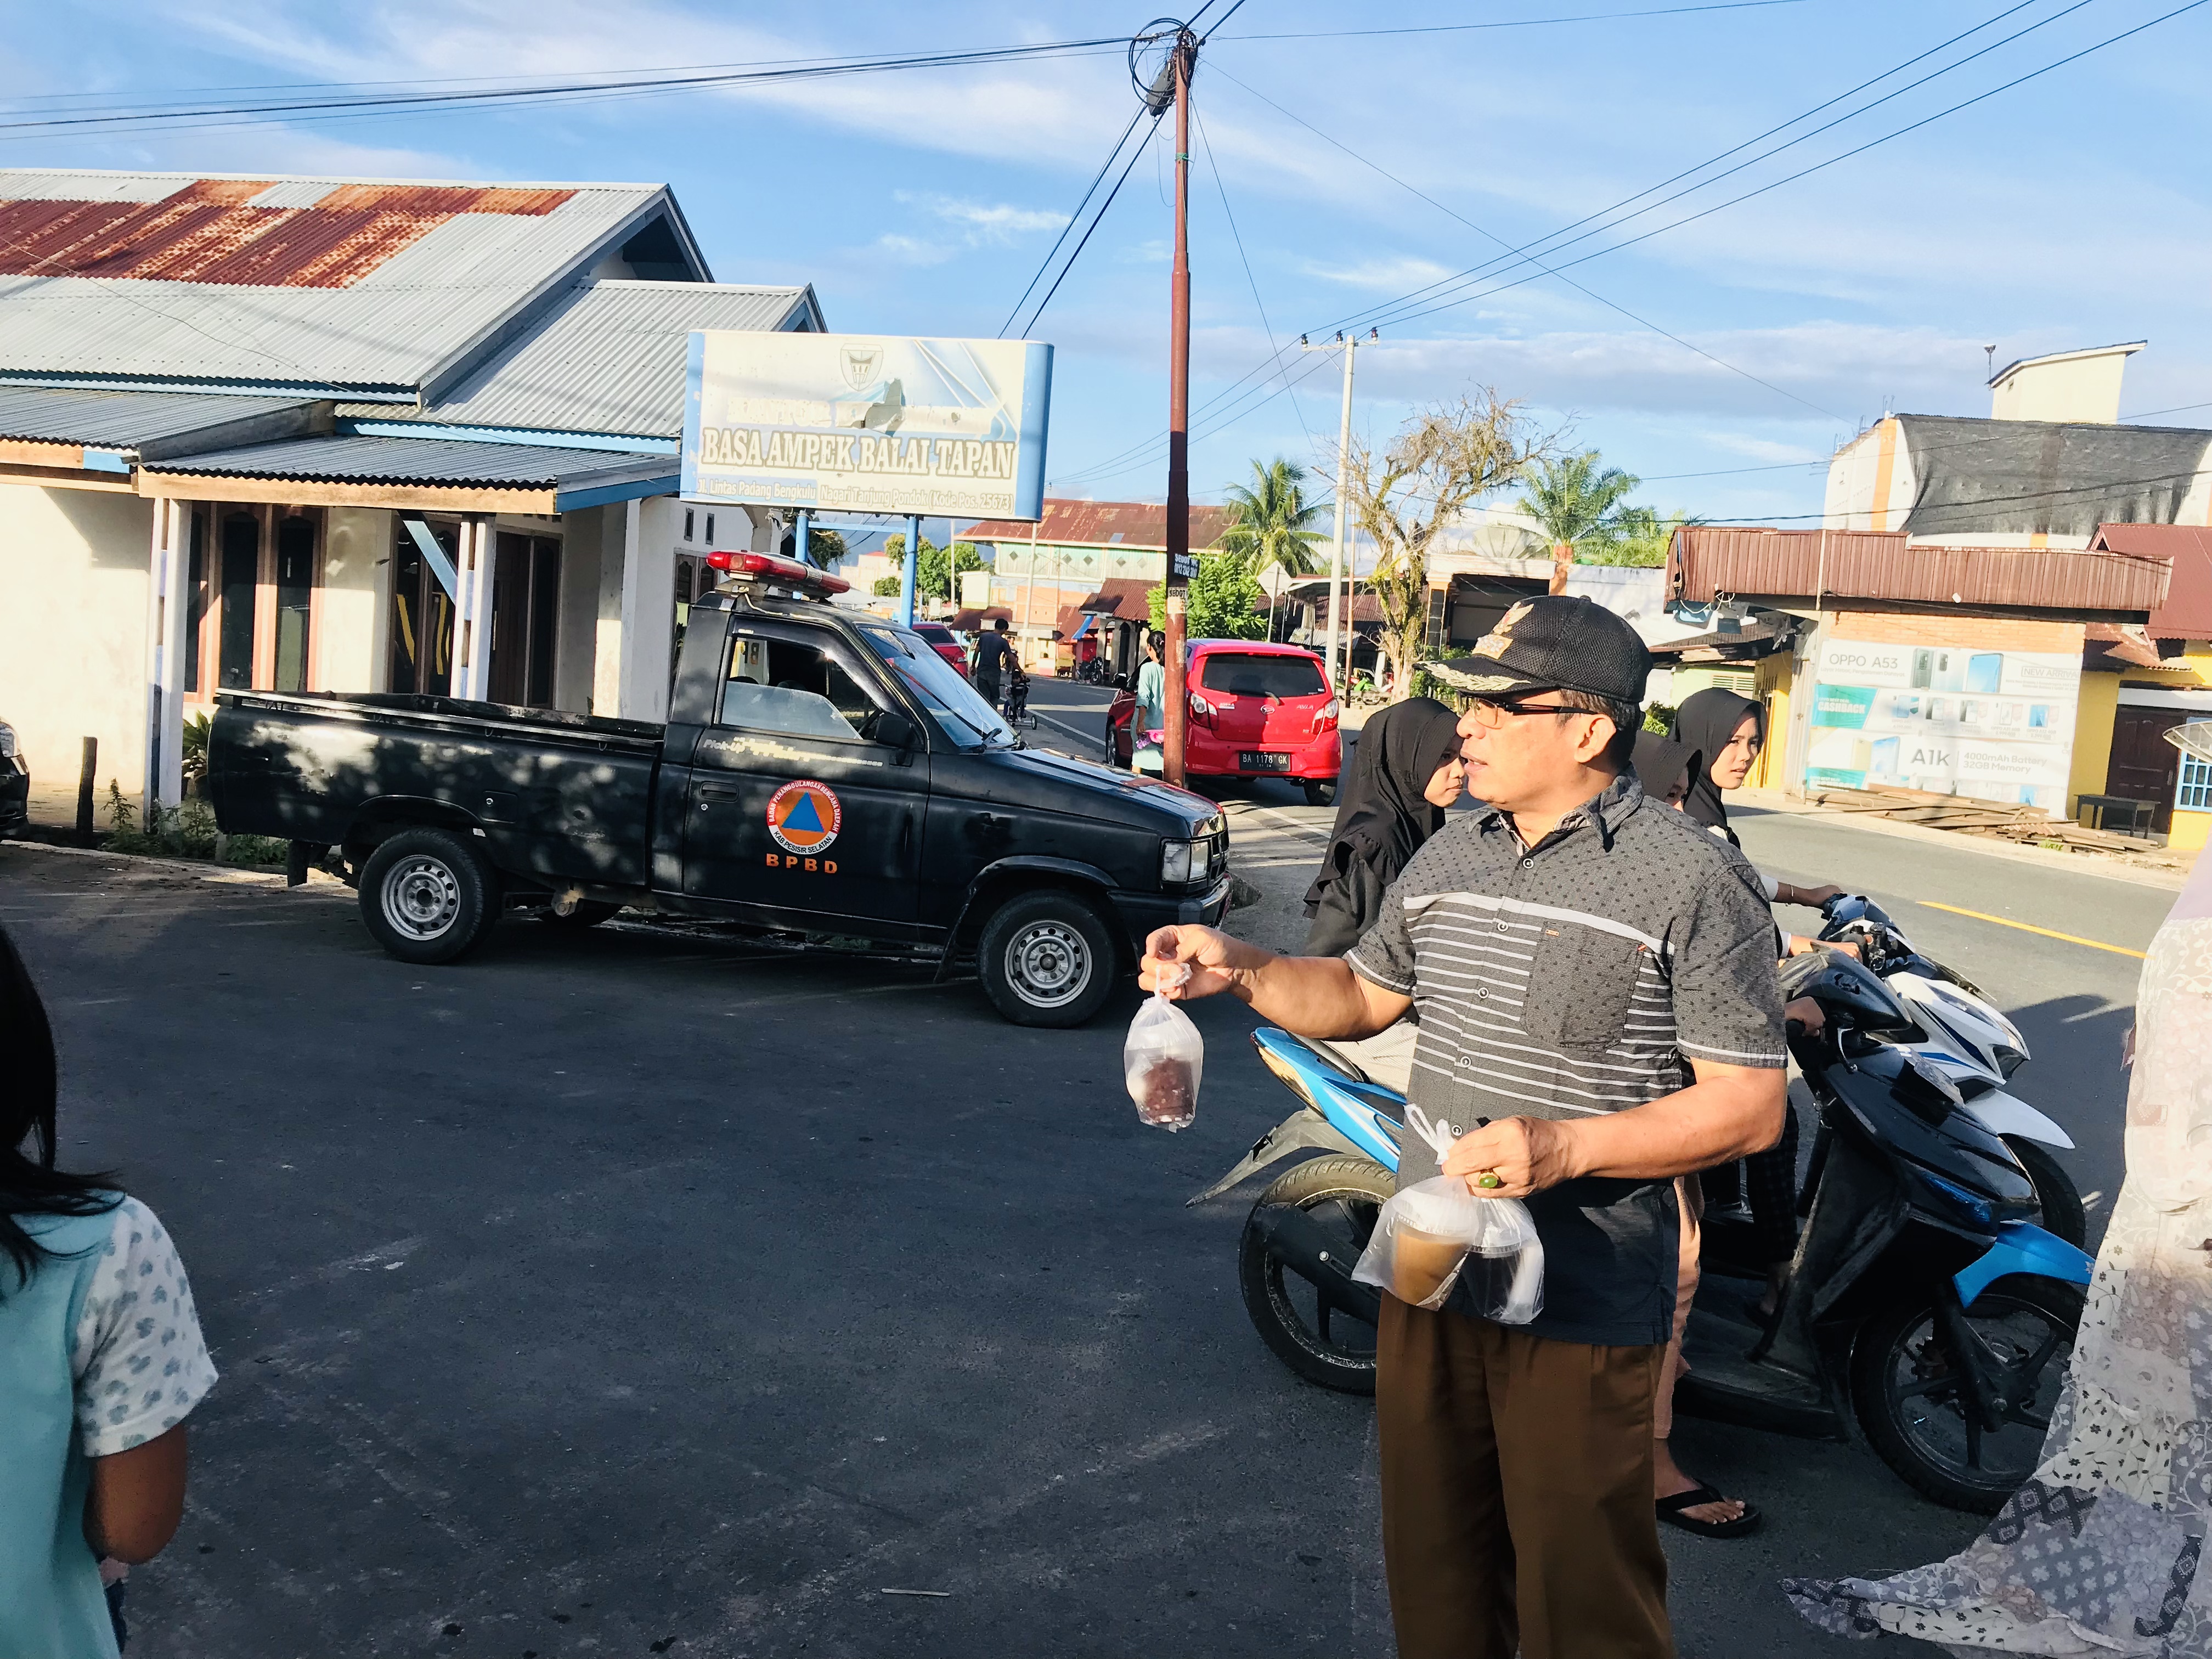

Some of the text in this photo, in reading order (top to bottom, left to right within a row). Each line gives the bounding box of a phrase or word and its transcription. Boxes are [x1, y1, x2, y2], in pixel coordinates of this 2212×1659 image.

[702, 427, 1015, 479] BASA AMPEK BALAI TAPAN
[697, 478, 1014, 514] Jl. Lintas Padang Bengkulu Nagari Tanjung Pondok (Kode Pos. 25673)
[1175, 553, 1199, 567] SEDOT WC
[1169, 589, 1186, 599] SEDOT
[1829, 653, 1898, 669] OPPO A53
[2024, 668, 2045, 676] NEW
[1818, 701, 1866, 714] CASHBACK
[703, 739, 746, 754] Pick-Up
[1243, 754, 1287, 764] BA 1178 GK
[1963, 752, 2047, 766] 4000mAh Battery
[1963, 760, 2032, 774] 32GB Memory
[769, 781, 840, 832] BADAN PENANGGULANGAN BENCANA DAERAH
[783, 841, 807, 853] PESISIR
[808, 836, 832, 853] SELATAN
[766, 853, 838, 874] BPBD
